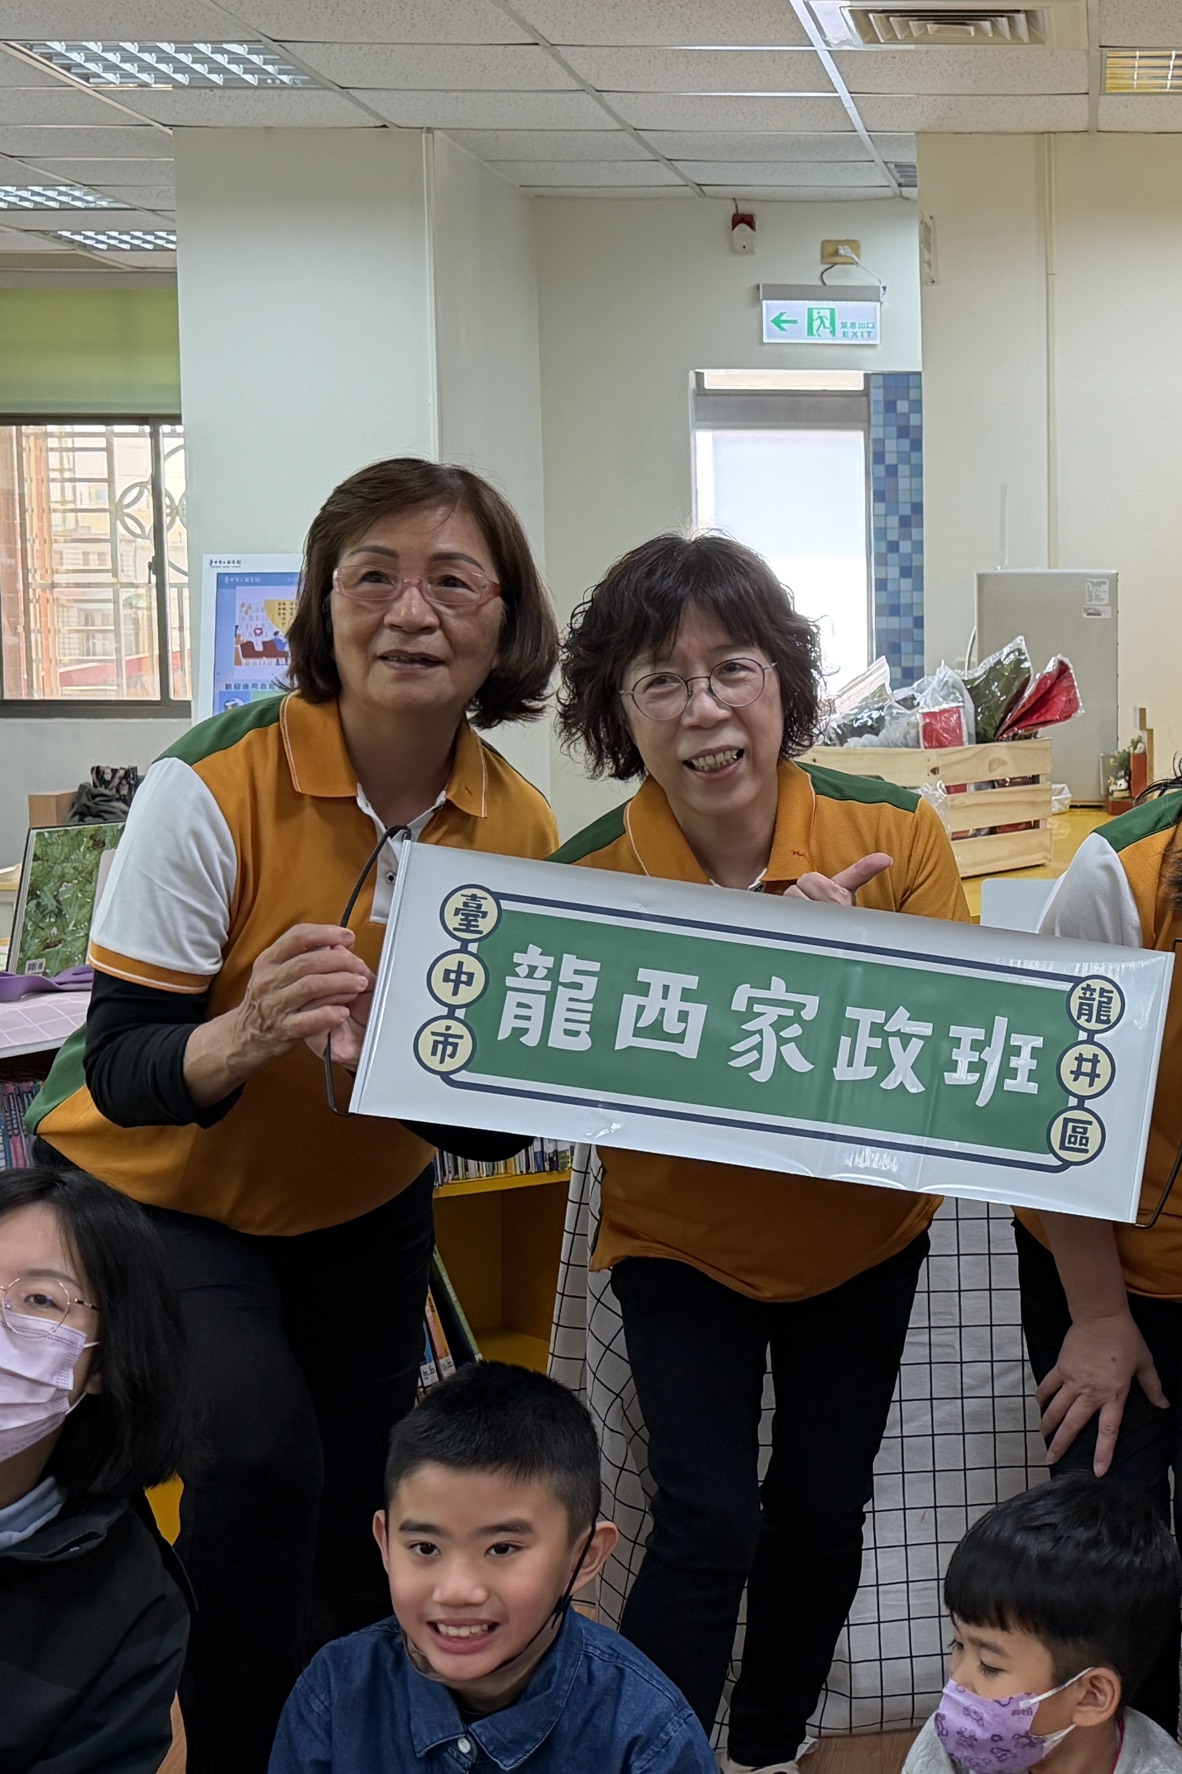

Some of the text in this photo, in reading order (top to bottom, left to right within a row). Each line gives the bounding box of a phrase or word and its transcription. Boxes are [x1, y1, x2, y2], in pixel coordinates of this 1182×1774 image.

[842, 330, 873, 338] EXIT
[430, 893, 489, 1065] 臺中市
[497, 943, 1043, 1107] 龍西家政班
[1059, 983, 1114, 1154] 龍井區
